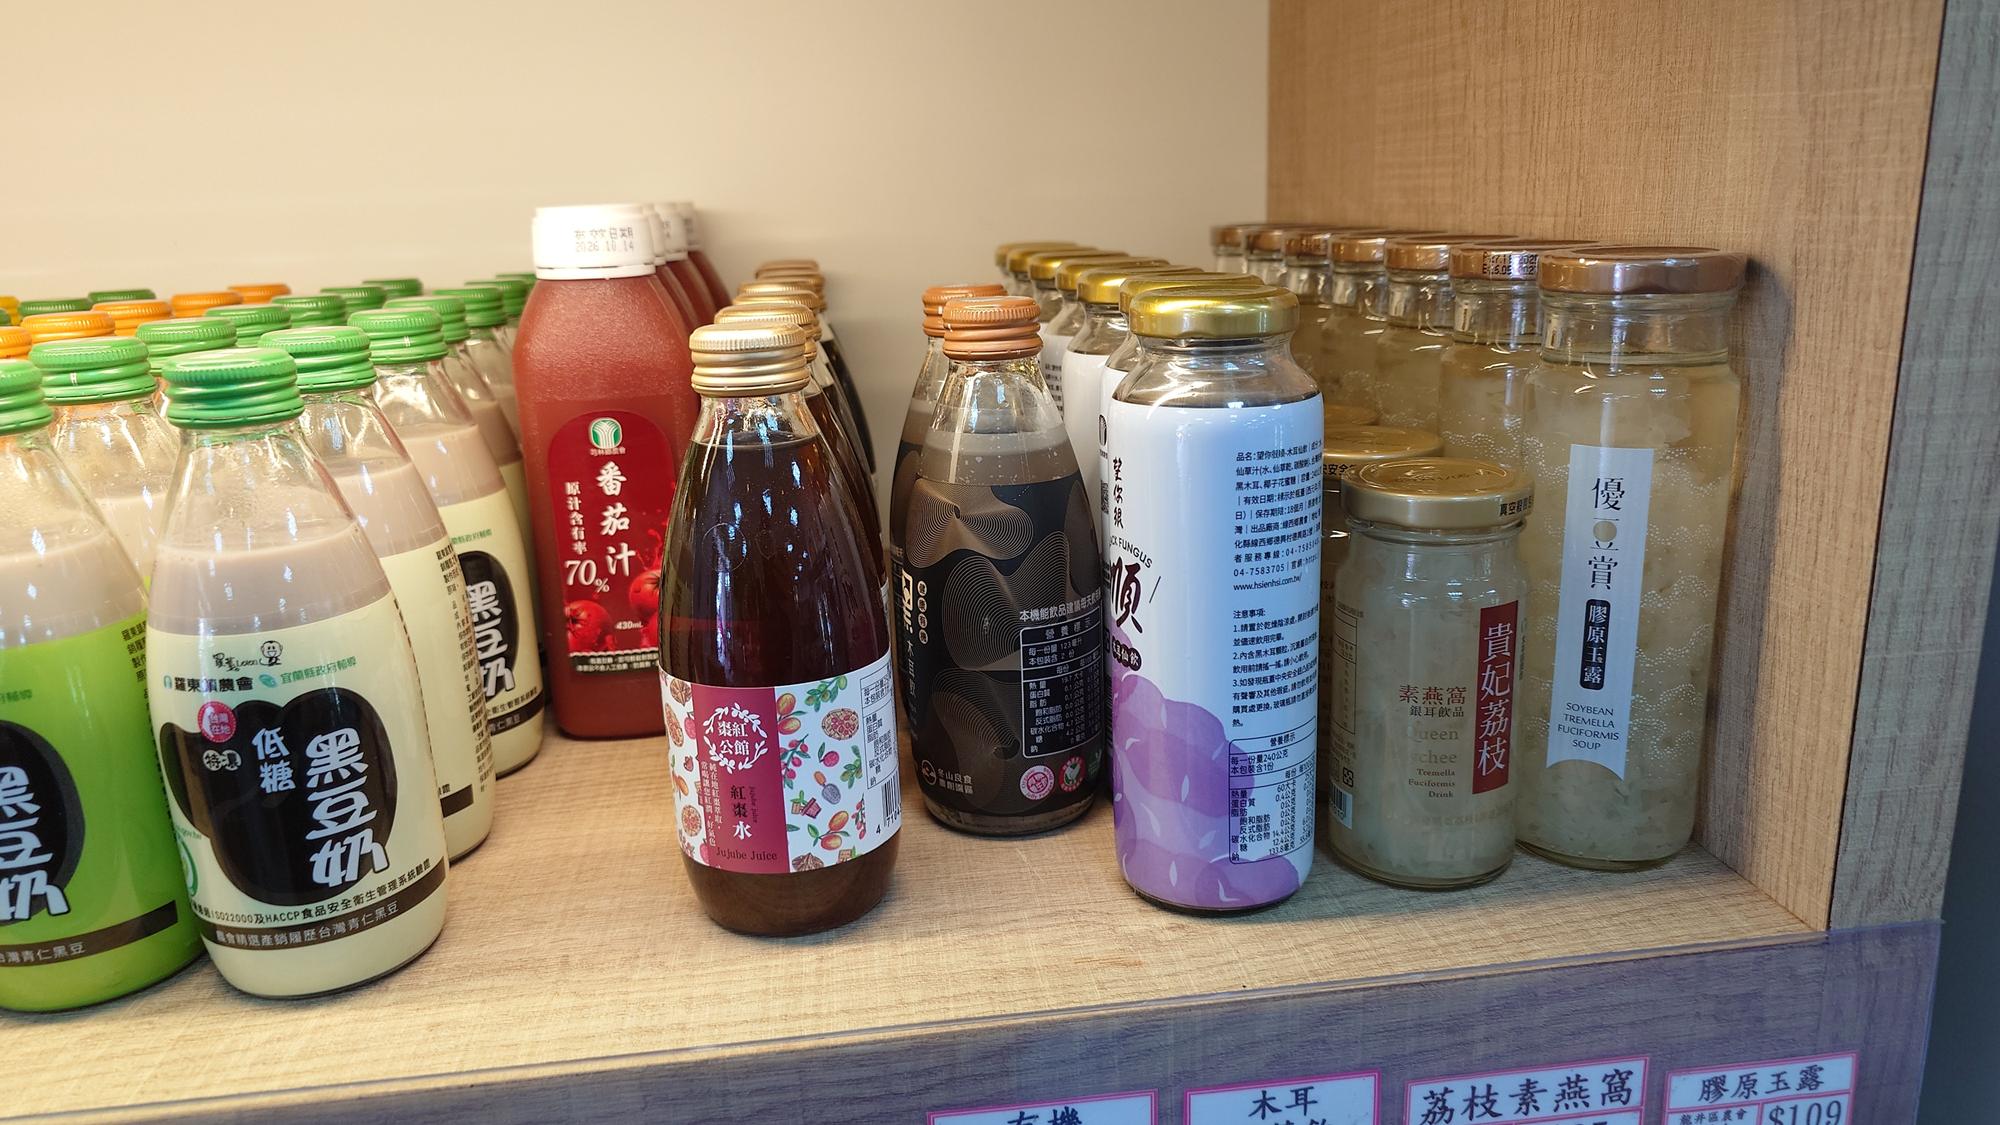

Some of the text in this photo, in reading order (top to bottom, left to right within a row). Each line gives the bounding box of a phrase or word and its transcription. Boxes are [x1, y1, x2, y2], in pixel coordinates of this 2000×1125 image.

[565, 481, 588, 555] 原汁含有率
[597, 461, 637, 577] 番茄汁
[1118, 539, 1153, 569] FUNGUS
[565, 560, 610, 593] 70%
[1233, 563, 1285, 577] 04-7583705
[465, 580, 522, 698] 黑豆奶
[1583, 604, 1608, 685] 膠原玉露
[174, 676, 254, 693] 羅東鎮農會
[1399, 684, 1467, 706] 素燕窩
[1477, 622, 1514, 778] 貴妃荔枝
[1409, 705, 1465, 718] 銀耳飲品
[1562, 712, 1616, 729] TREMELLA
[1565, 701, 1615, 717] SOYBEAN
[1557, 723, 1620, 741] FUCIFORMIS
[1571, 738, 1602, 751] SOUP
[251, 727, 297, 794] 低糖
[305, 727, 391, 889] 黑豆奶
[1428, 790, 1454, 799] Drink
[730, 784, 753, 841] 紅棗水
[876, 823, 882, 835] 4
[0, 767, 71, 923] 黑豆奶
[716, 846, 778, 862] Jujube Juice
[1419, 1068, 1634, 1125] 荔枝素燕窩
[1698, 1064, 1825, 1104] 膠原玉露
[1248, 1086, 1318, 1120] 木耳
[1768, 1099, 1843, 1125] $109
